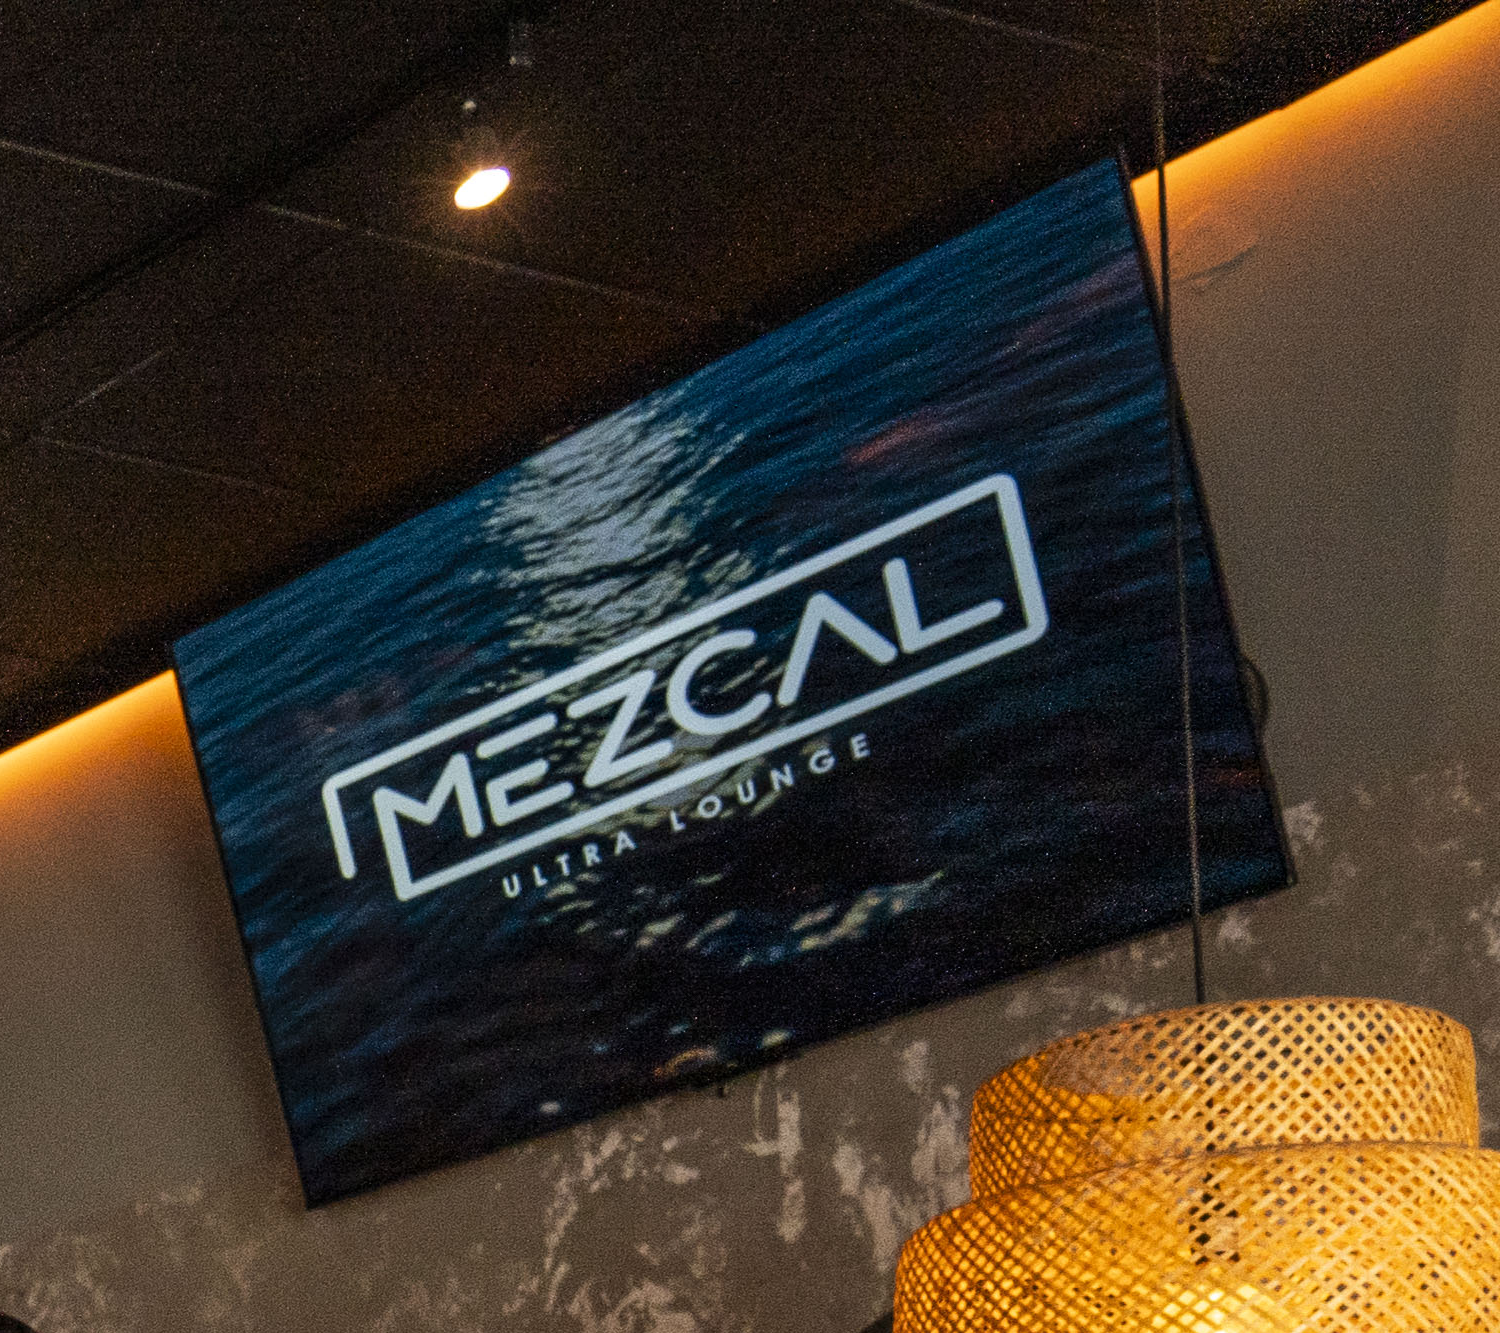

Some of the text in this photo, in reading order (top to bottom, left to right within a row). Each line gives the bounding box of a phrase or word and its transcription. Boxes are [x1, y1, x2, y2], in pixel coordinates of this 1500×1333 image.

[371, 556, 1004, 850] MEZCAL
[500, 732, 873, 900] ULTRA LOUNGE
